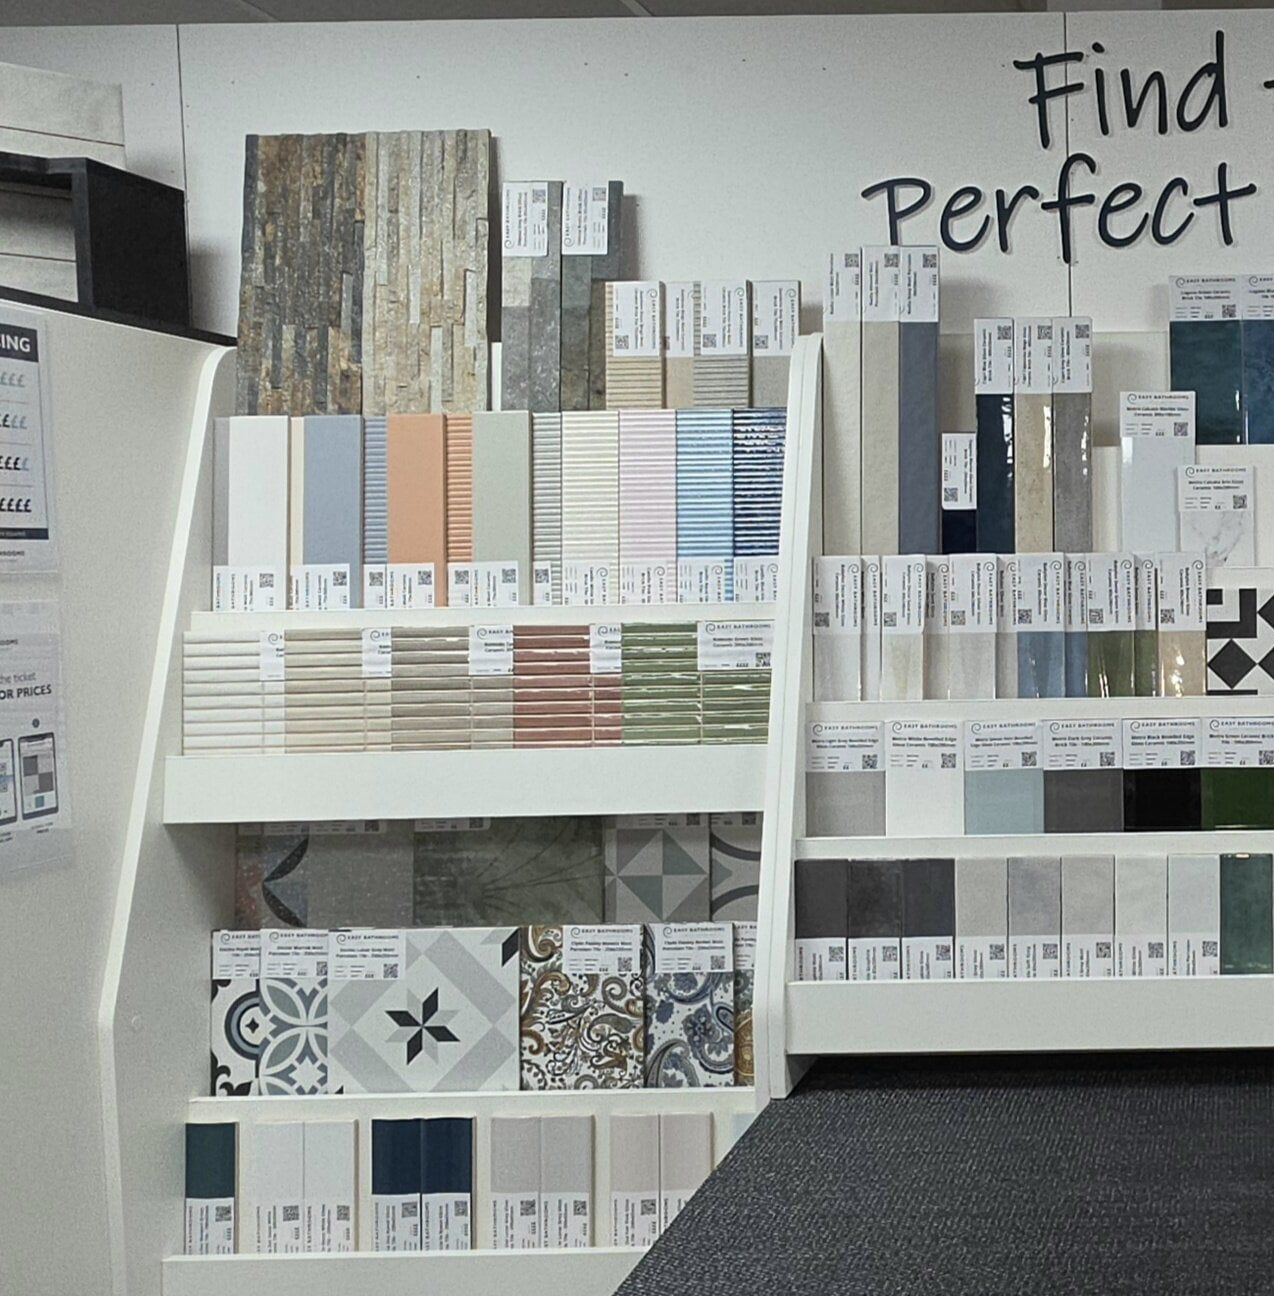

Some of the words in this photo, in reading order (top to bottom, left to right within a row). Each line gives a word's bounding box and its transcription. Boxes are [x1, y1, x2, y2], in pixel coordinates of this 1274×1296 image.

[1012, 30, 1229, 149] Find
[861, 152, 1258, 265] Perfect
[0, 333, 31, 353] ING
[16, 683, 53, 699] PRICES
